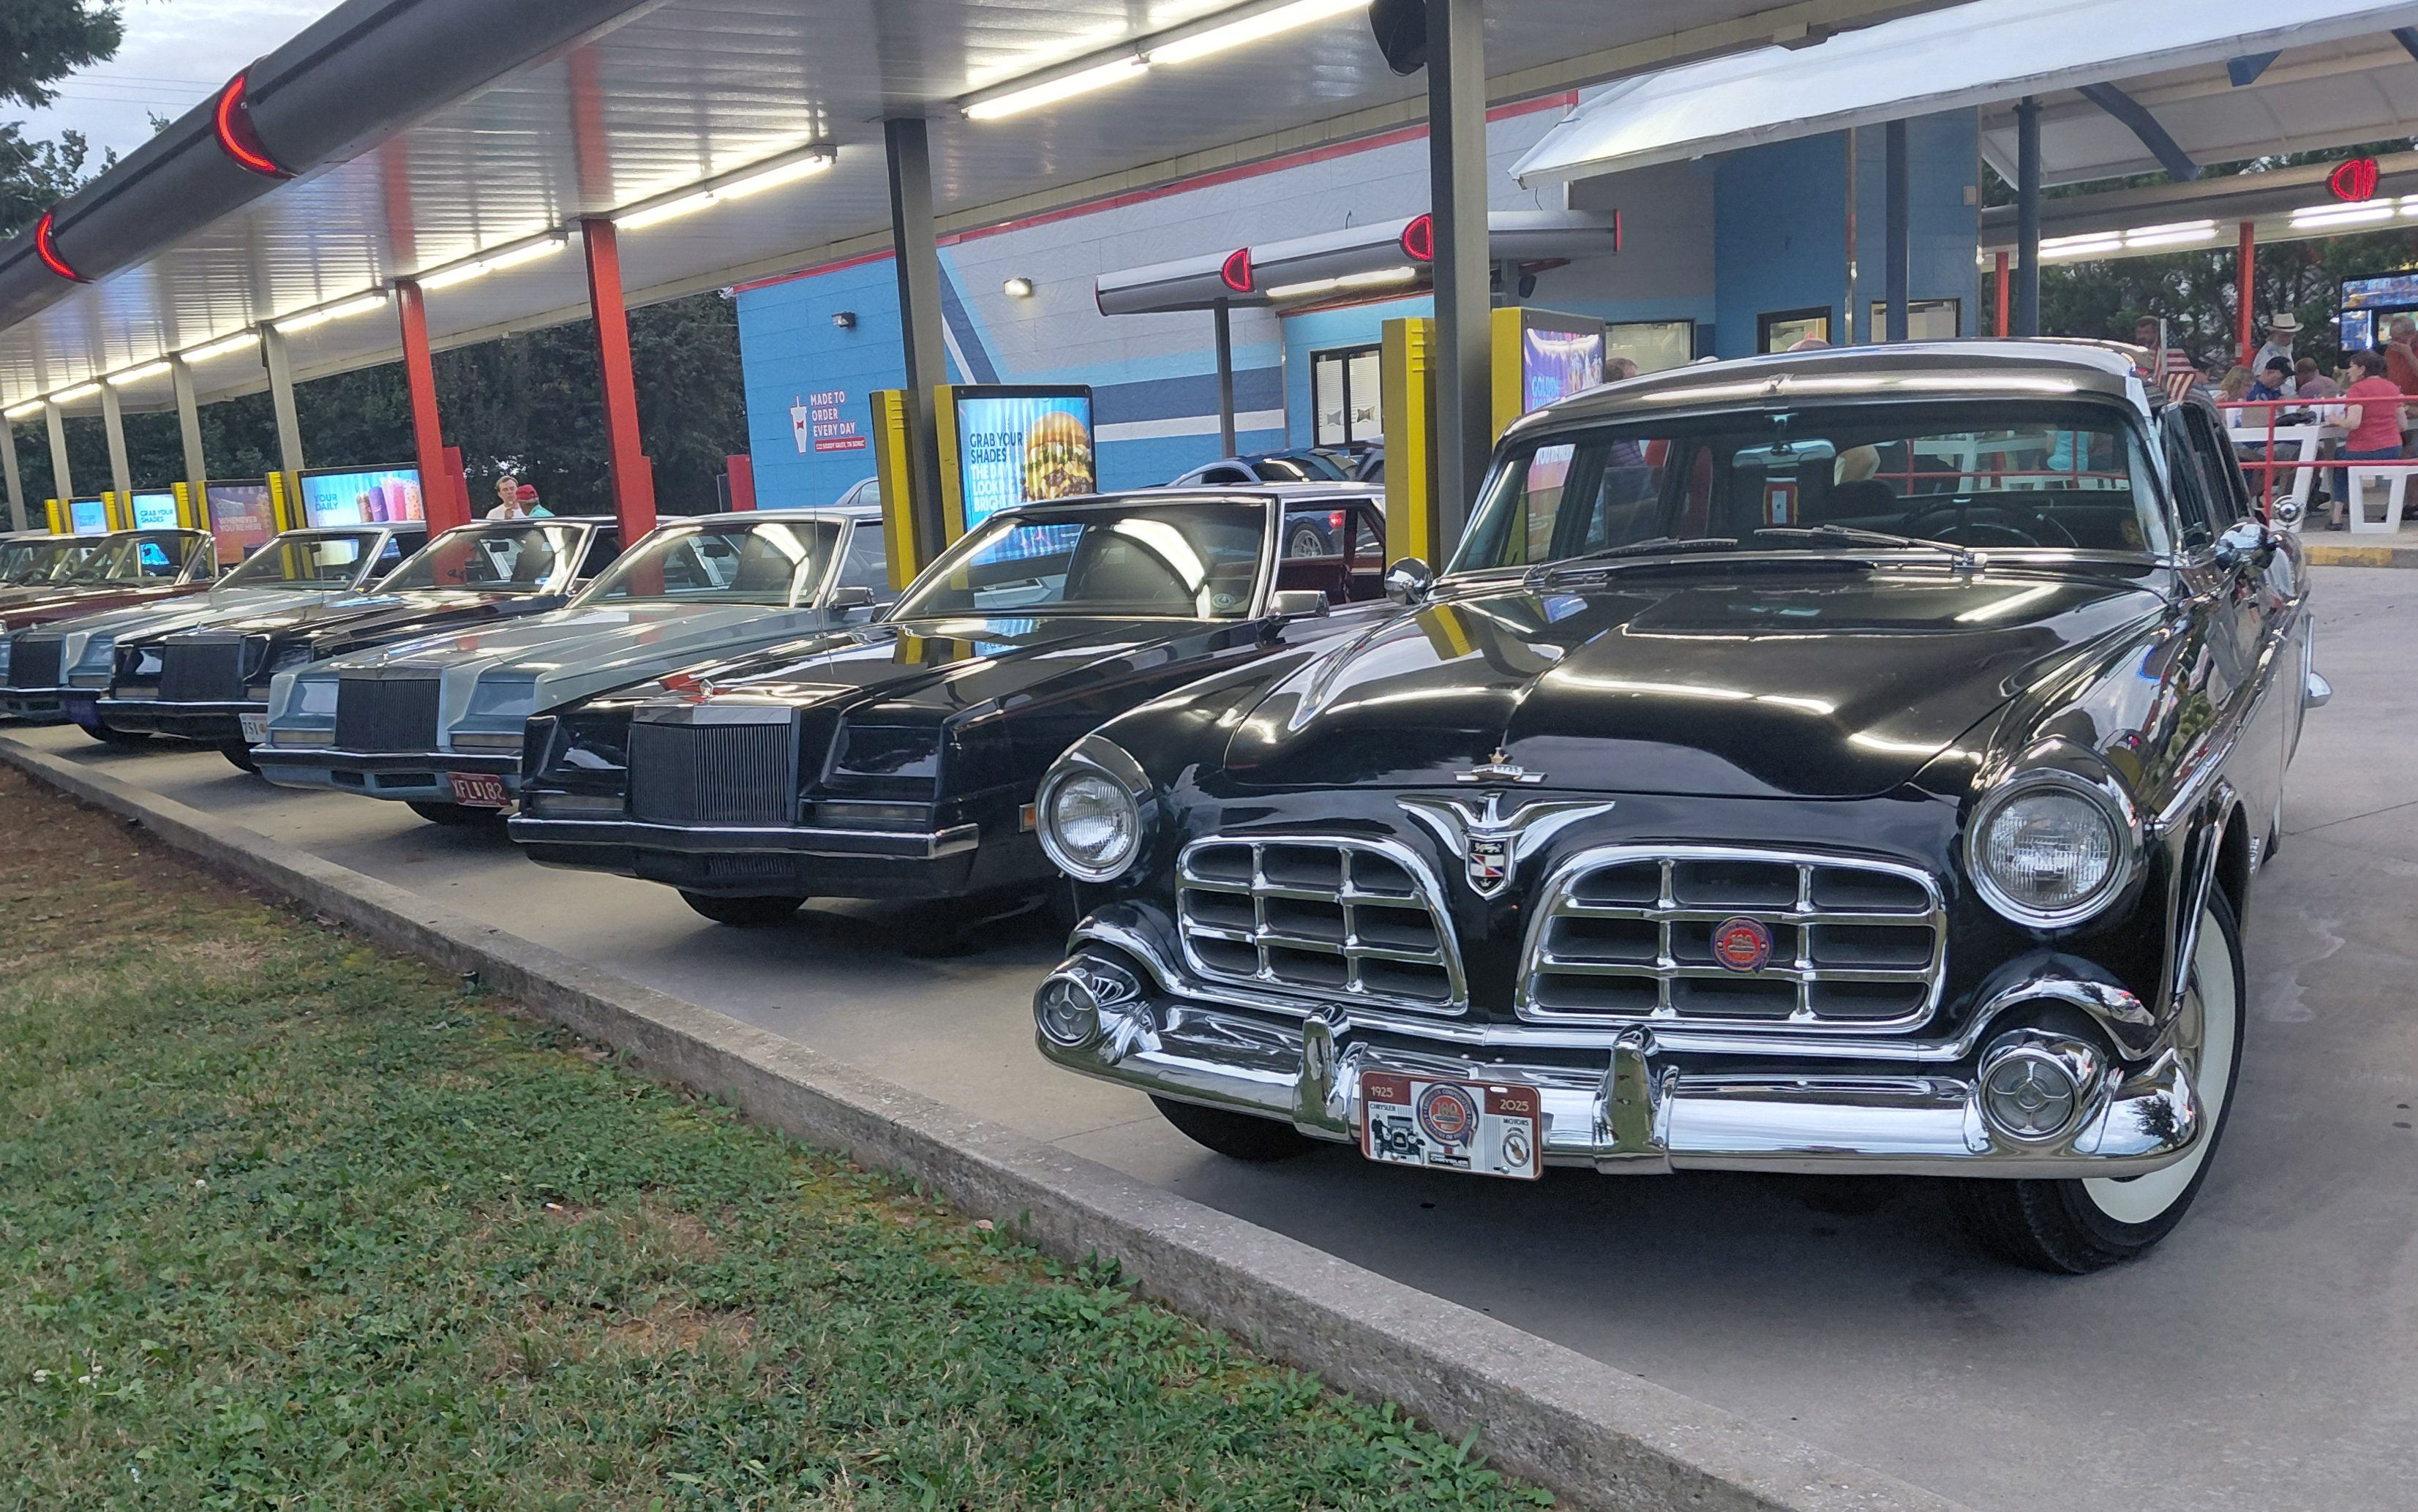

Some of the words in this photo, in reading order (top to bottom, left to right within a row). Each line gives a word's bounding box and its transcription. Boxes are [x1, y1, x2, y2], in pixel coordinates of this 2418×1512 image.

[810, 391, 833, 406] MADE
[833, 390, 845, 404] TO
[811, 408, 838, 422] ORDER
[813, 423, 838, 437] EVERY
[839, 421, 855, 435] DAY
[969, 432, 996, 448] GRAB
[996, 432, 1023, 446] YOUR
[970, 448, 1007, 464] SHADES
[971, 464, 989, 480] THE
[314, 494, 337, 503] YOUR
[315, 503, 338, 511] DAILY
[1370, 1086, 1394, 1098] 1925
[1498, 1099, 1530, 1112] 2025
